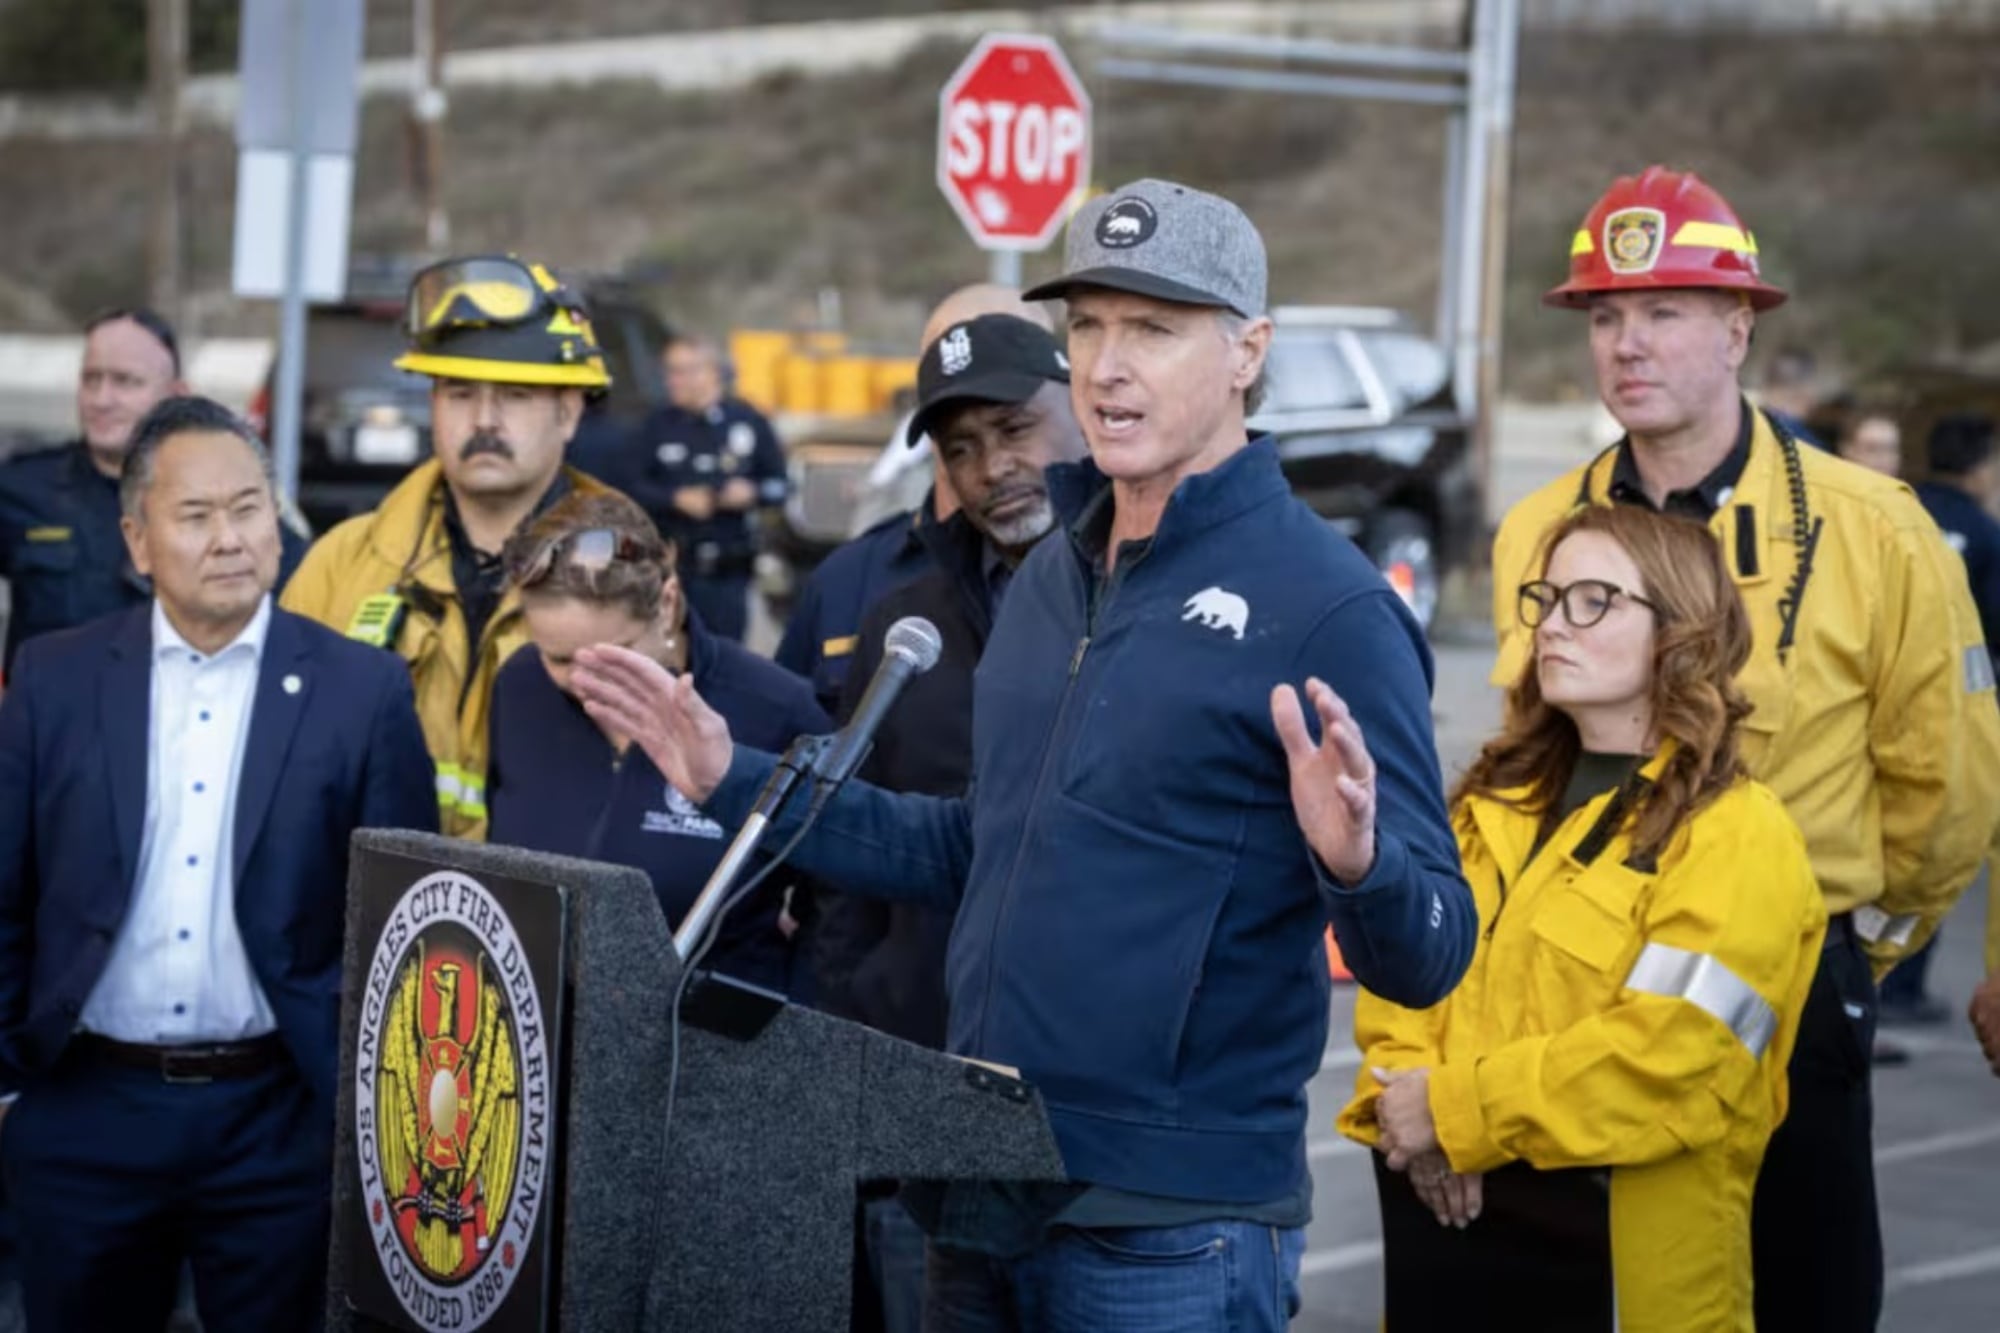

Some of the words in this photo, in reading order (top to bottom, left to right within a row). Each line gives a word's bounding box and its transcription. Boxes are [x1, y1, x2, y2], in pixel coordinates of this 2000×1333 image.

[948, 99, 1084, 184] STOP
[409, 880, 454, 925] CITY
[457, 882, 505, 948] FIRE
[359, 912, 408, 1092] ANGELES
[501, 936, 546, 1242] DEPARTMENT
[359, 1106, 378, 1187] LOS
[379, 1228, 463, 1329] FOUNDED
[468, 1261, 504, 1319] 1886
